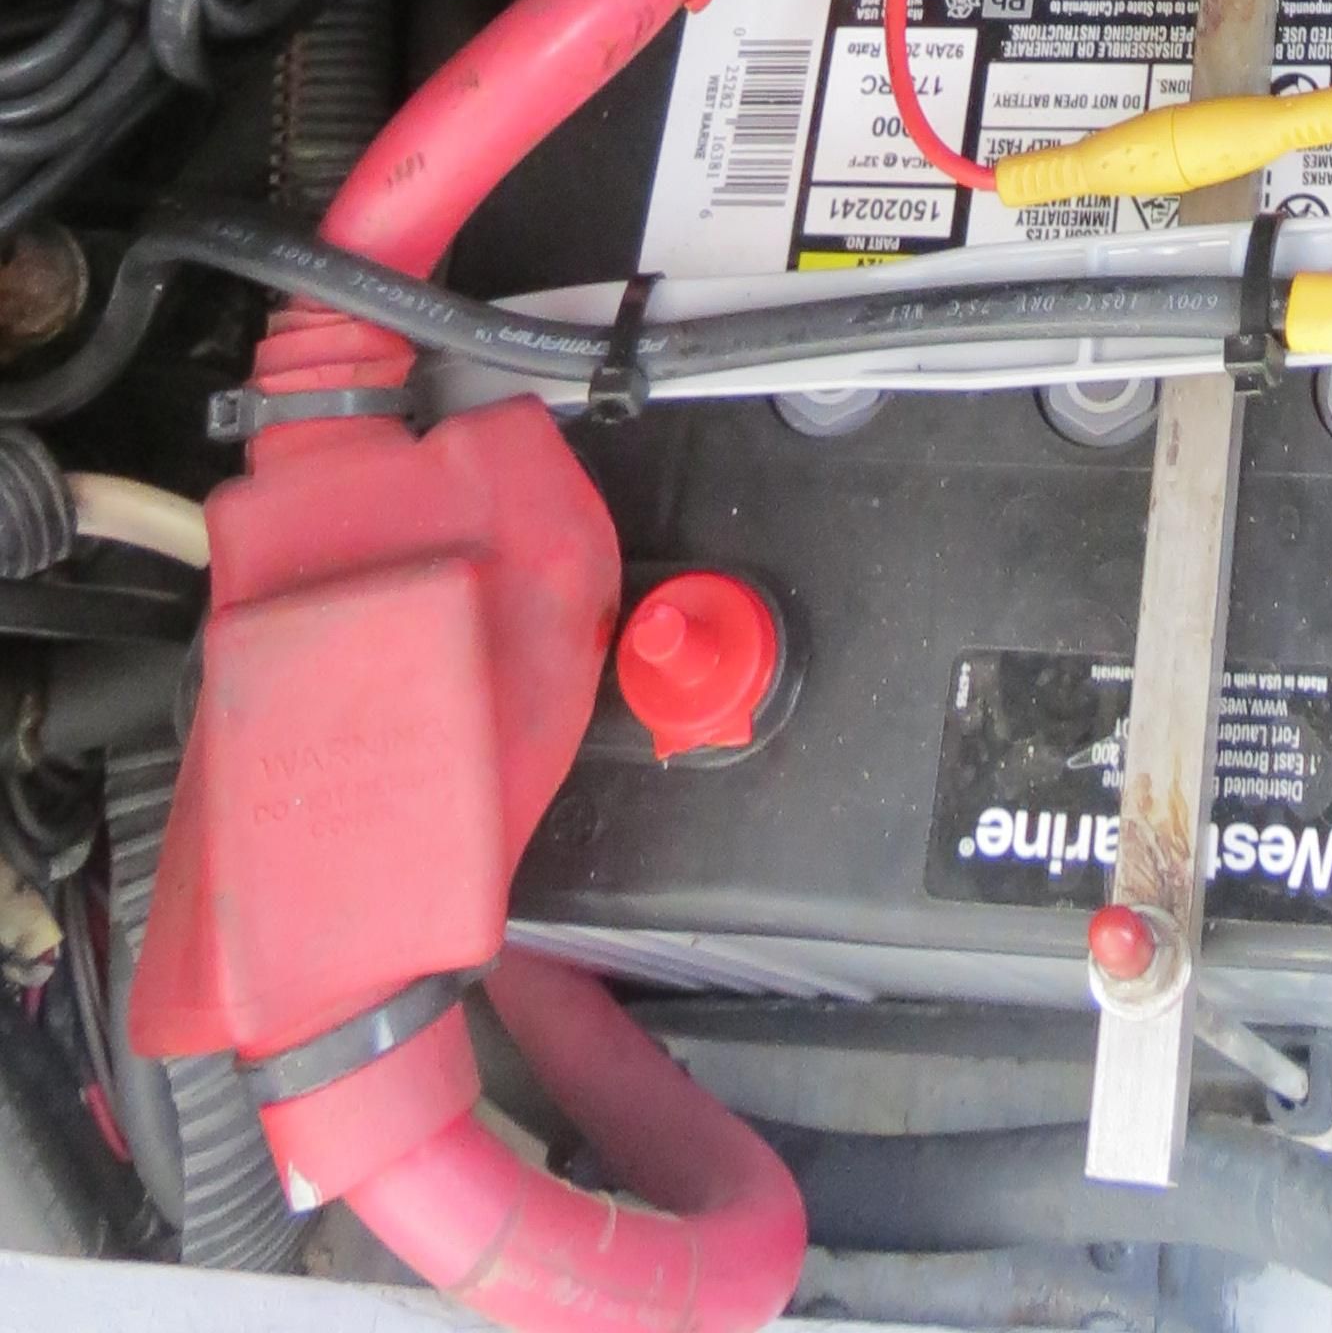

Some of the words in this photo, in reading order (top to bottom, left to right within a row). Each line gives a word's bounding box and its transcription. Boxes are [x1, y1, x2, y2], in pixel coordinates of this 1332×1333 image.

[1063, 0, 1112, 16] California
[1126, 1, 1154, 16] State
[1008, 24, 1101, 40] INSTRUCTIONS.
[1104, 25, 1167, 40] CHARGING
[847, 42, 881, 58] Rate
[925, 43, 964, 60] 92Ah
[1000, 40, 1076, 57] INCINERATE.
[1077, 41, 1095, 57] OR
[1097, 41, 1184, 58] DISASSEMBLE
[705, 75, 722, 112] WEST
[719, 64, 739, 110] 25282
[992, 92, 1050, 107] BATTERY.
[1053, 93, 1088, 107] OPEN
[1092, 94, 1118, 108] NOT
[1122, 94, 1141, 108] DO
[694, 115, 714, 161] MARINE
[705, 132, 727, 180] 16381
[828, 198, 941, 222] 15020241
[1016, 210, 1110, 227] IMMEDIATELY
[872, 236, 900, 251] PART
[1016, 295, 1056, 313] DRY
[1166, 293, 1219, 311] 600V
[1297, 675, 1327, 692] Made
[1272, 726, 1300, 748] Fort
[1273, 753, 1304, 774] East
[1223, 776, 1303, 802] Distributed
